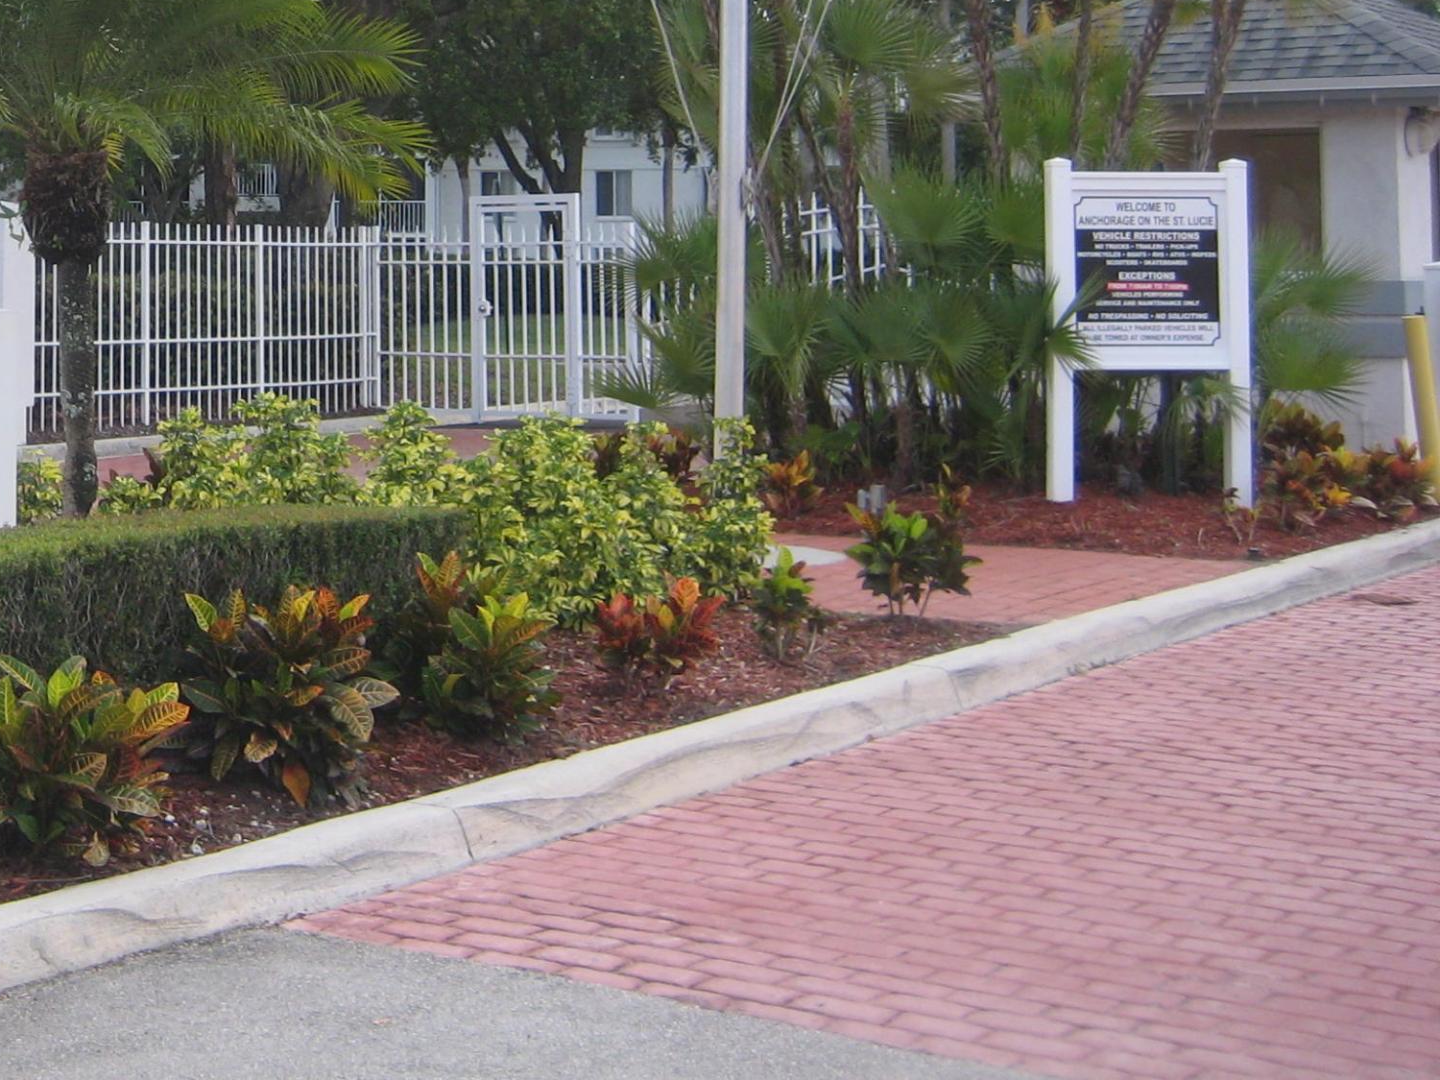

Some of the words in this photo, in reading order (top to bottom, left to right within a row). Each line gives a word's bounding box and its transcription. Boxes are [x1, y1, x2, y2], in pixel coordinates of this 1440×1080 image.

[1115, 202, 1162, 212] WELCOME
[1164, 202, 1176, 212] TO
[1078, 216, 1135, 226] ANCHORAGE
[1137, 216, 1151, 226] ON
[1153, 216, 1170, 226] THE
[1187, 216, 1214, 226] LUCIE
[1092, 231, 1131, 241] VEHICLE
[1133, 231, 1201, 241] RESTRICTIONS
[1118, 271, 1176, 281] EXCEPTIONS
